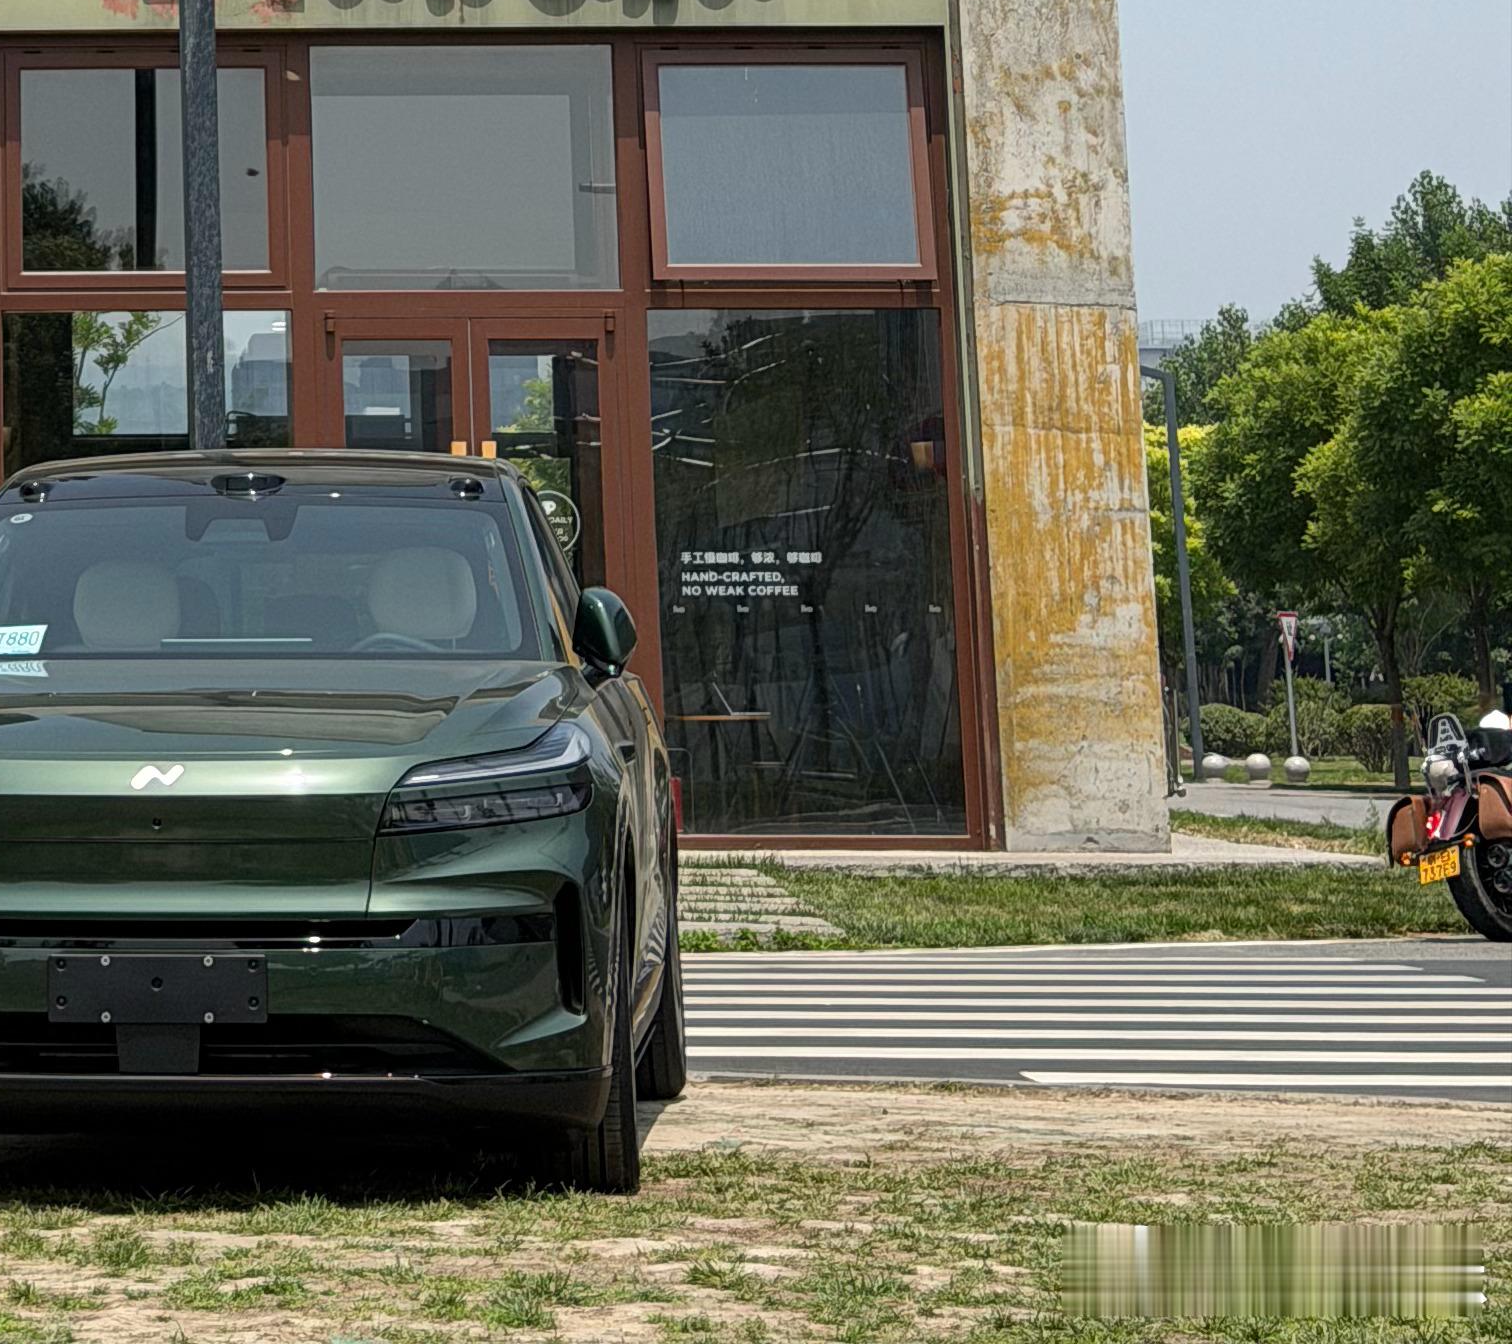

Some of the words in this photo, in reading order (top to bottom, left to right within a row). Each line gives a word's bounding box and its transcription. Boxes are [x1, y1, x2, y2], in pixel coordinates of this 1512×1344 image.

[681, 570, 785, 584] HAND-CRAFTED,
[681, 585, 702, 597] NO
[704, 585, 745, 597] WEAK
[747, 585, 799, 597] COFFEE
